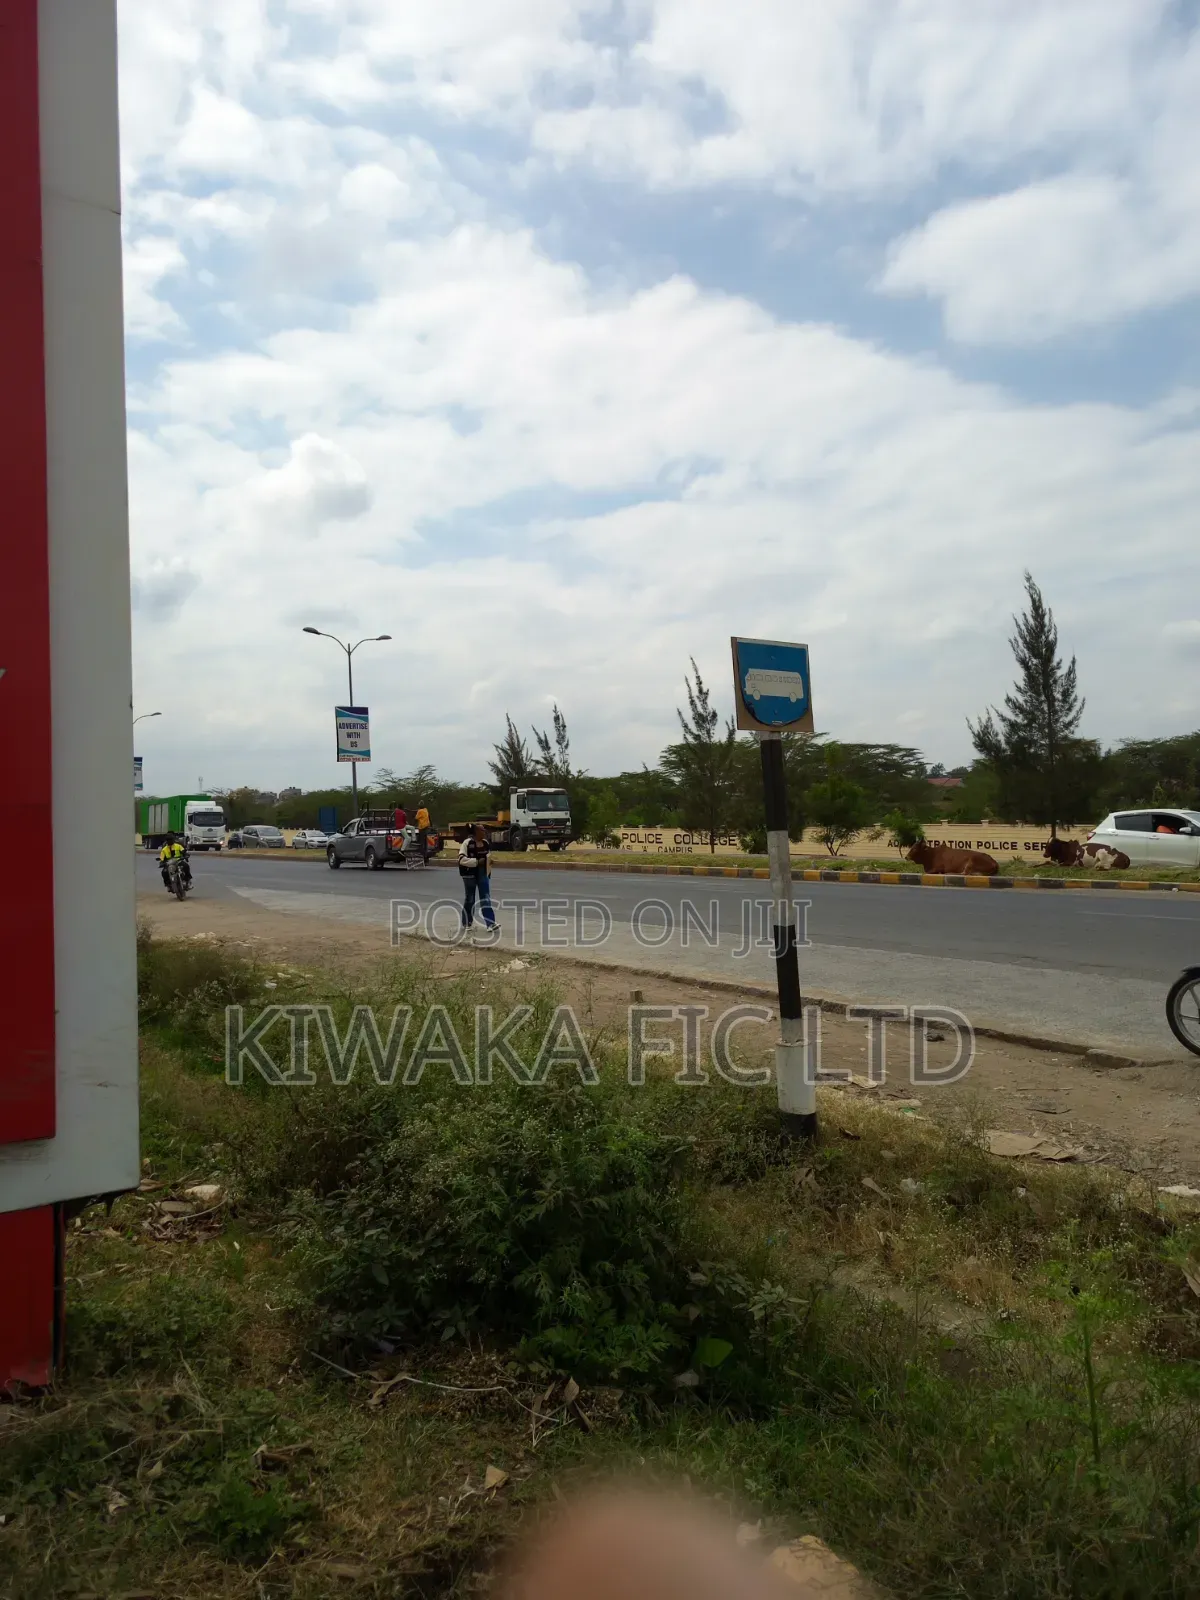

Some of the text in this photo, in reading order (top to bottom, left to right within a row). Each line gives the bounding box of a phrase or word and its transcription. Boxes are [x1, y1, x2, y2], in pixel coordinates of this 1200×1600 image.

[621, 832, 663, 844] POLICE
[657, 845, 693, 854] CAMPUS
[976, 840, 1018, 850] POLICE
[1023, 841, 1048, 851] SER
